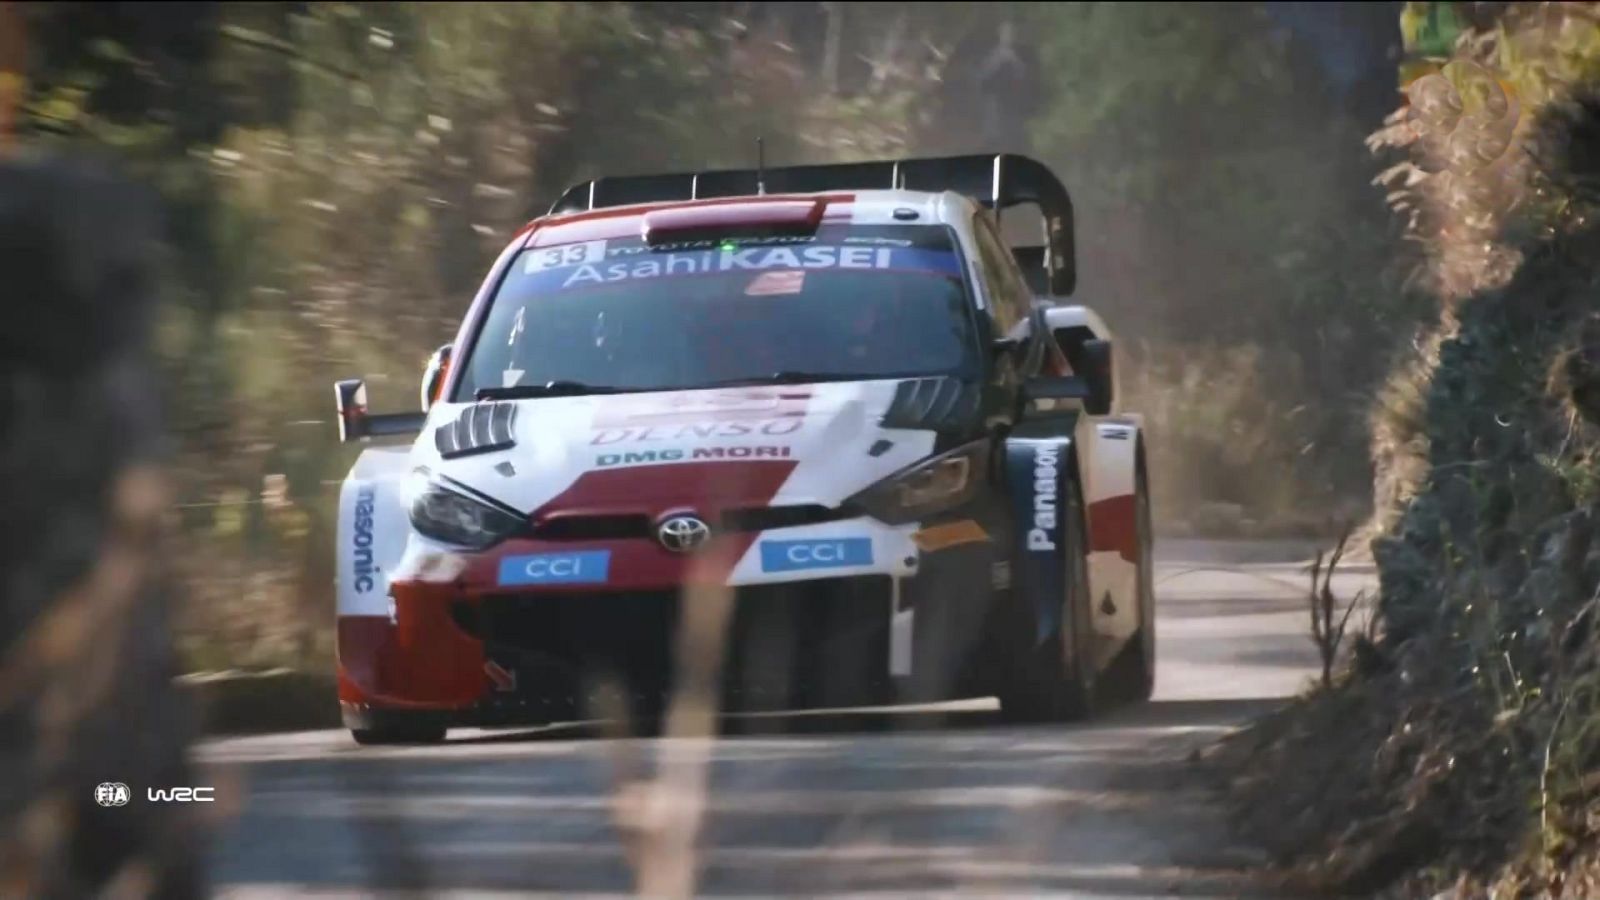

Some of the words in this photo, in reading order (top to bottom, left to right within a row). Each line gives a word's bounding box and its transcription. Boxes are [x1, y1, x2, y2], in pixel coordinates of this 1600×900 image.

[542, 244, 588, 268] 33
[589, 419, 804, 445] DENSO
[596, 449, 684, 467] DMG
[692, 446, 791, 460] MORI
[786, 543, 846, 563] CCI
[525, 558, 581, 578] CCI
